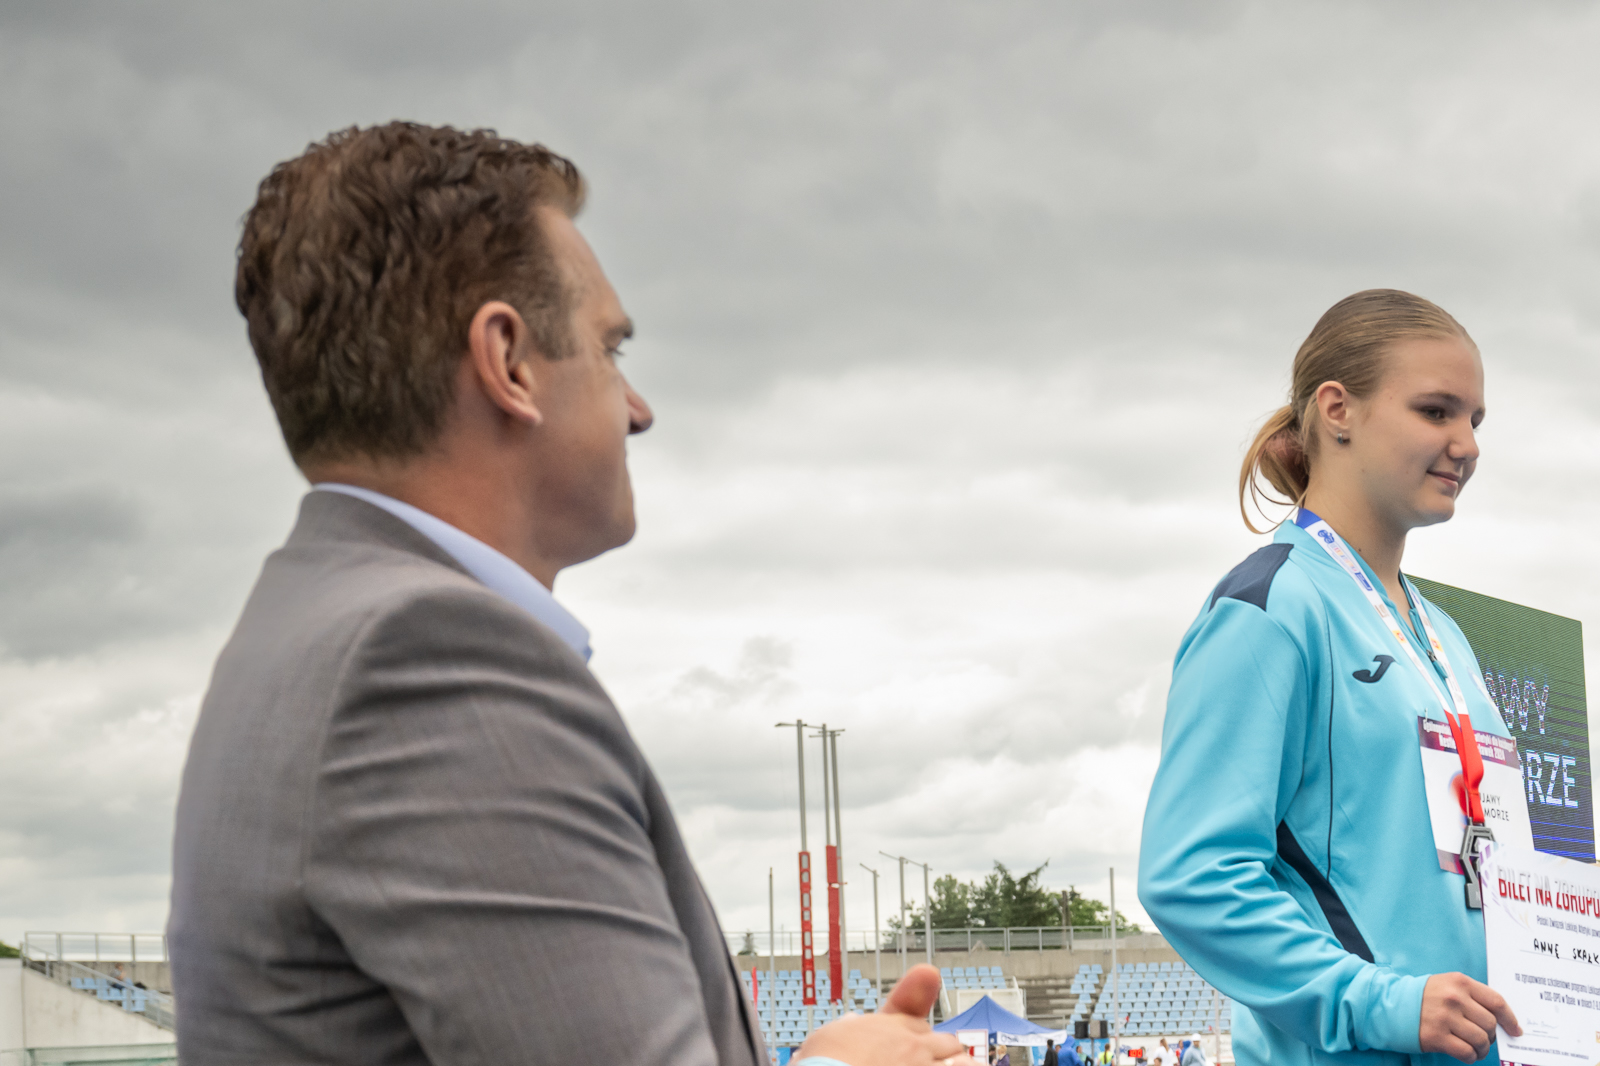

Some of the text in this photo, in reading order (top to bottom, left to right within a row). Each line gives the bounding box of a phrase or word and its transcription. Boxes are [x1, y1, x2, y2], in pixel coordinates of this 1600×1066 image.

[1482, 793, 1501, 805] JAWY
[1484, 807, 1510, 822] MORZE
[1497, 865, 1531, 903] BILET
[1535, 869, 1552, 908] NA
